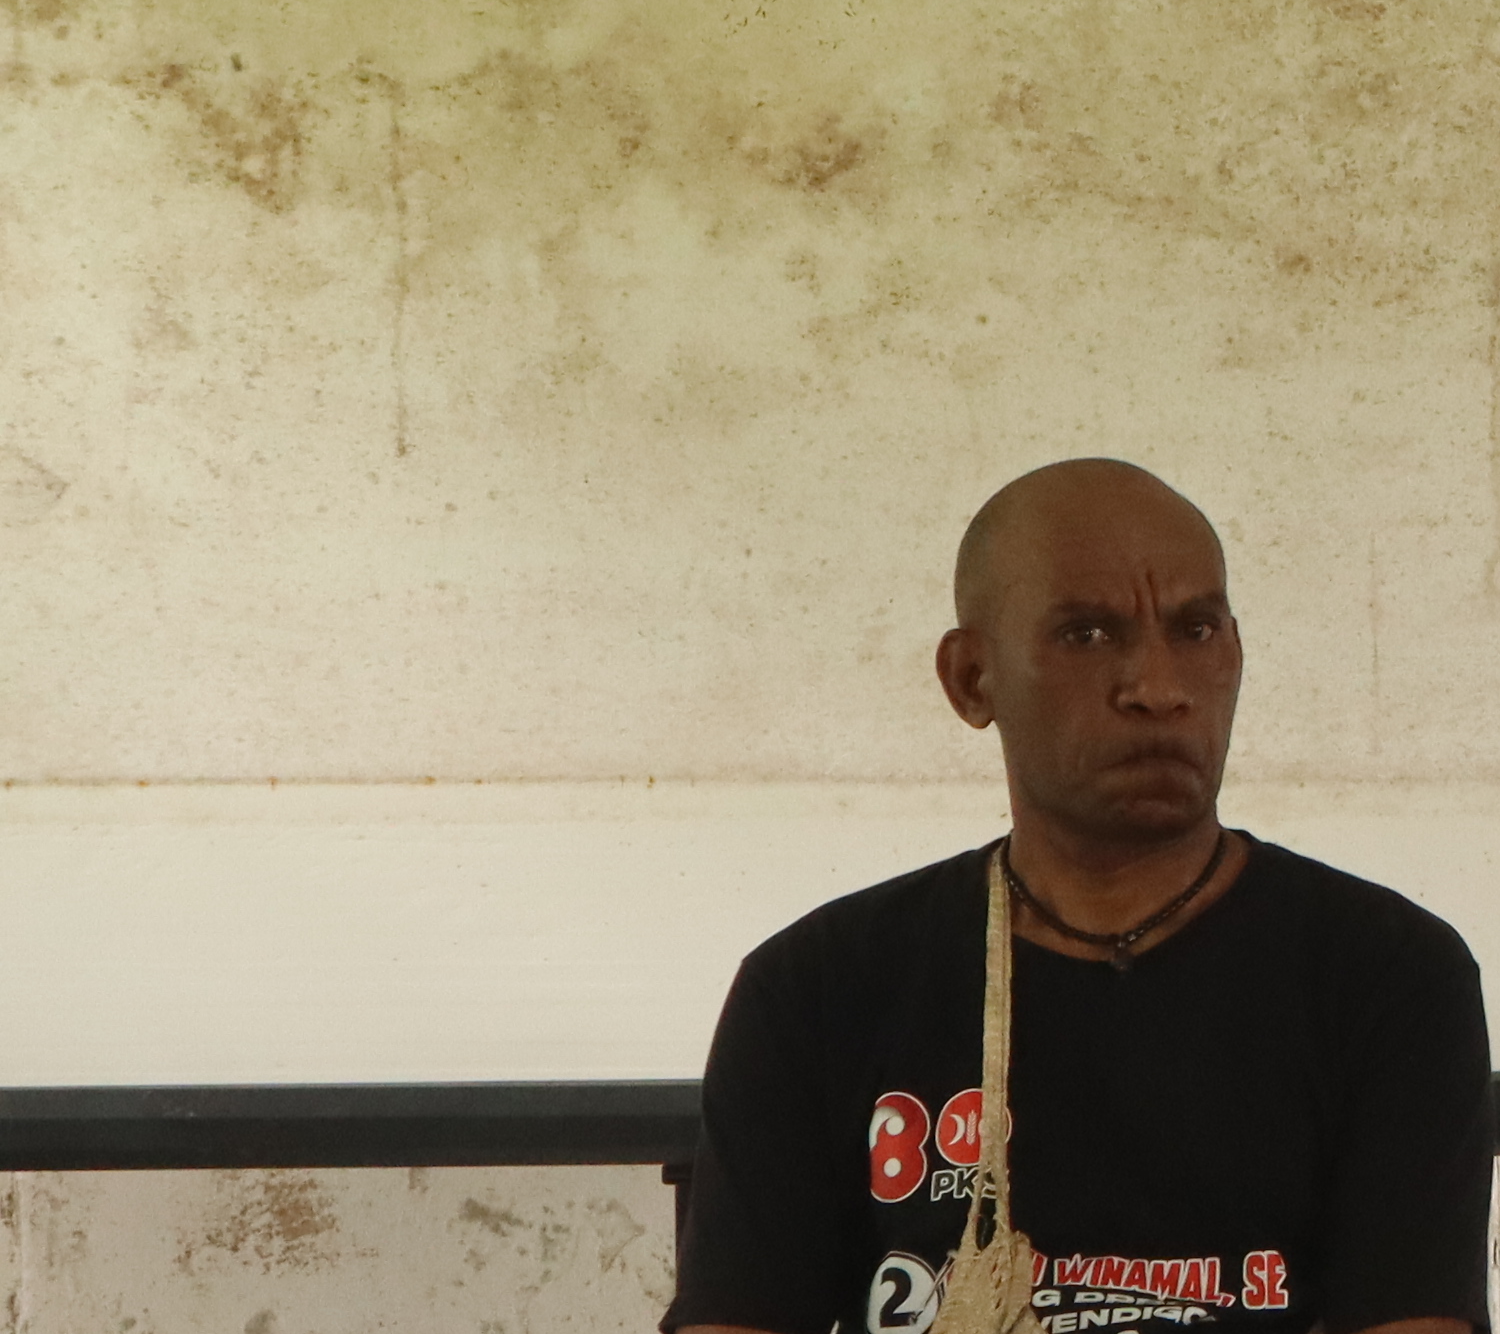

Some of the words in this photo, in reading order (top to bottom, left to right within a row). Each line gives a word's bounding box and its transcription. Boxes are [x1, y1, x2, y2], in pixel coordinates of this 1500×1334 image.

[879, 1267, 918, 1328] 2
[1053, 1253, 1236, 1307] WINAMAL,
[1242, 1250, 1289, 1310] SE
